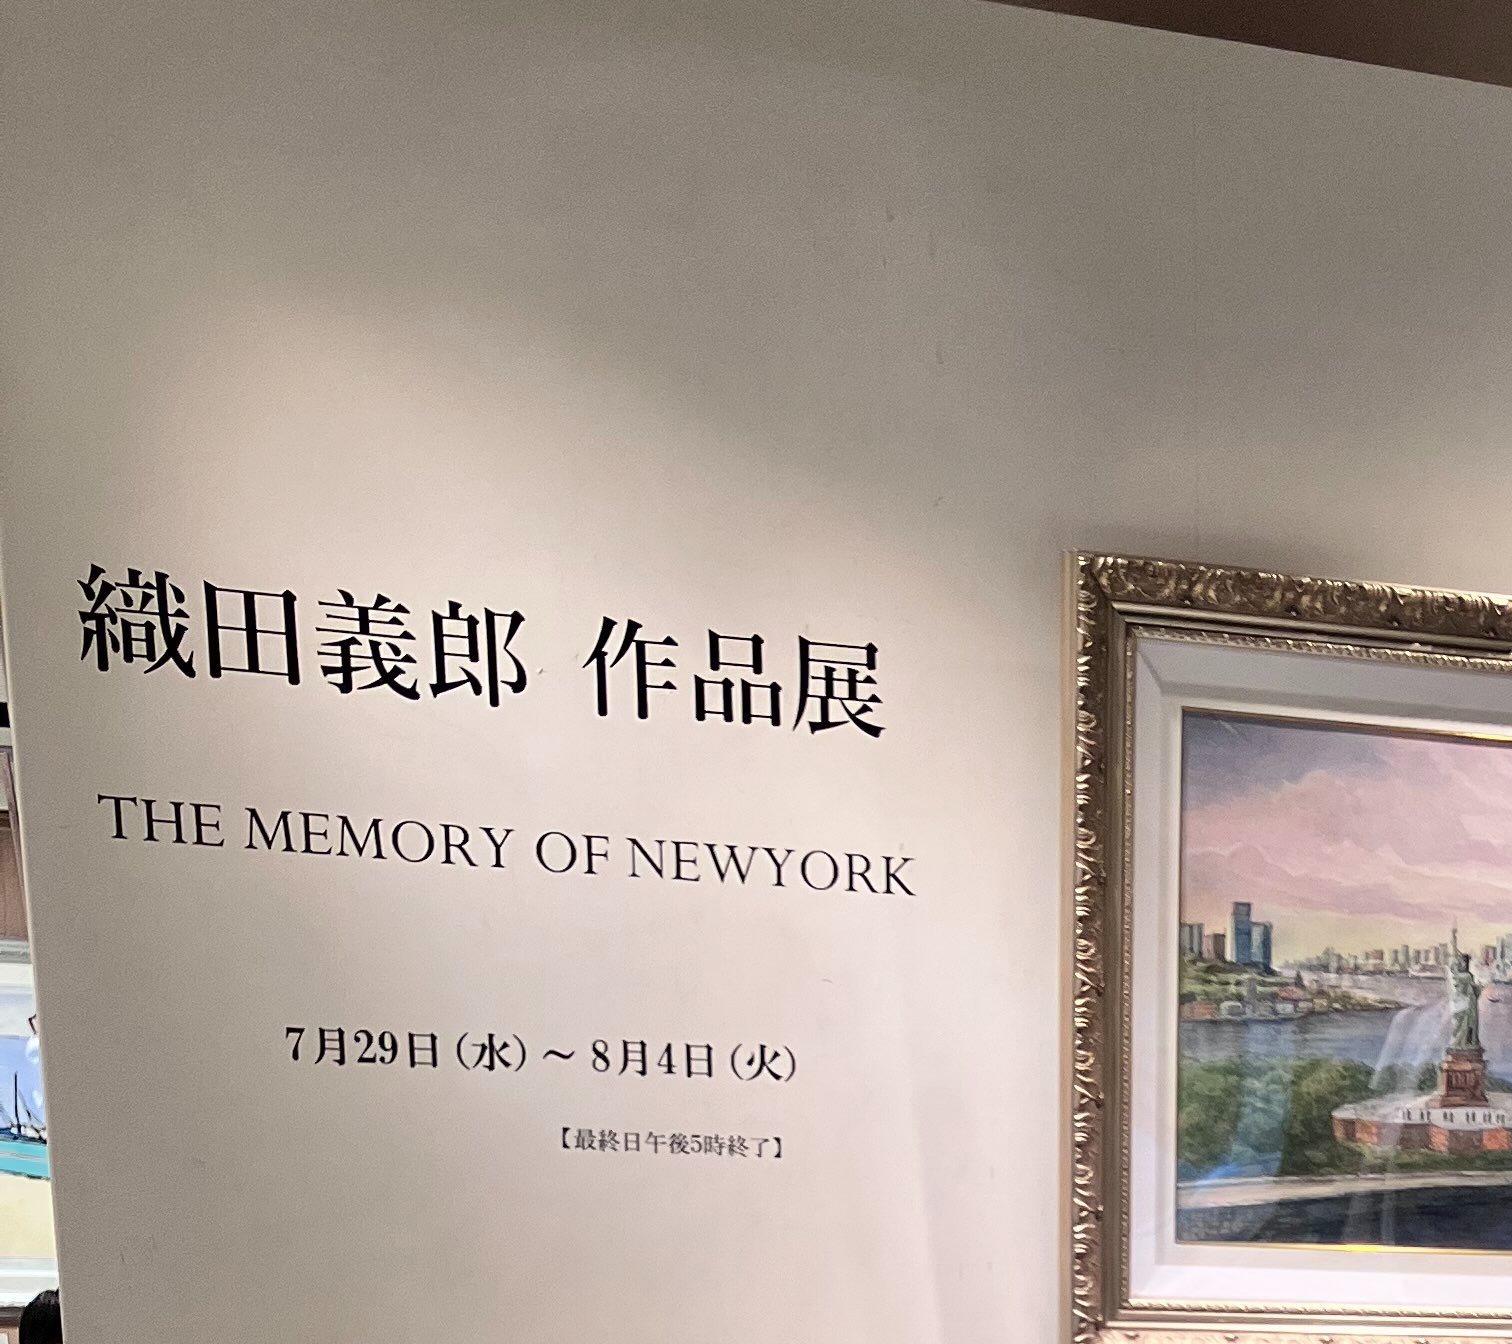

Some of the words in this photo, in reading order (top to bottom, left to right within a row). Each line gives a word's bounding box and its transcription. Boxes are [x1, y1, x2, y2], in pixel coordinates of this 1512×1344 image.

[72, 563, 528, 708] 織田義郎
[582, 616, 887, 738] 作品展
[97, 794, 225, 848] THE
[244, 807, 515, 873] MEMORY
[536, 832, 610, 875] OF
[627, 838, 917, 896] NEWYORK
